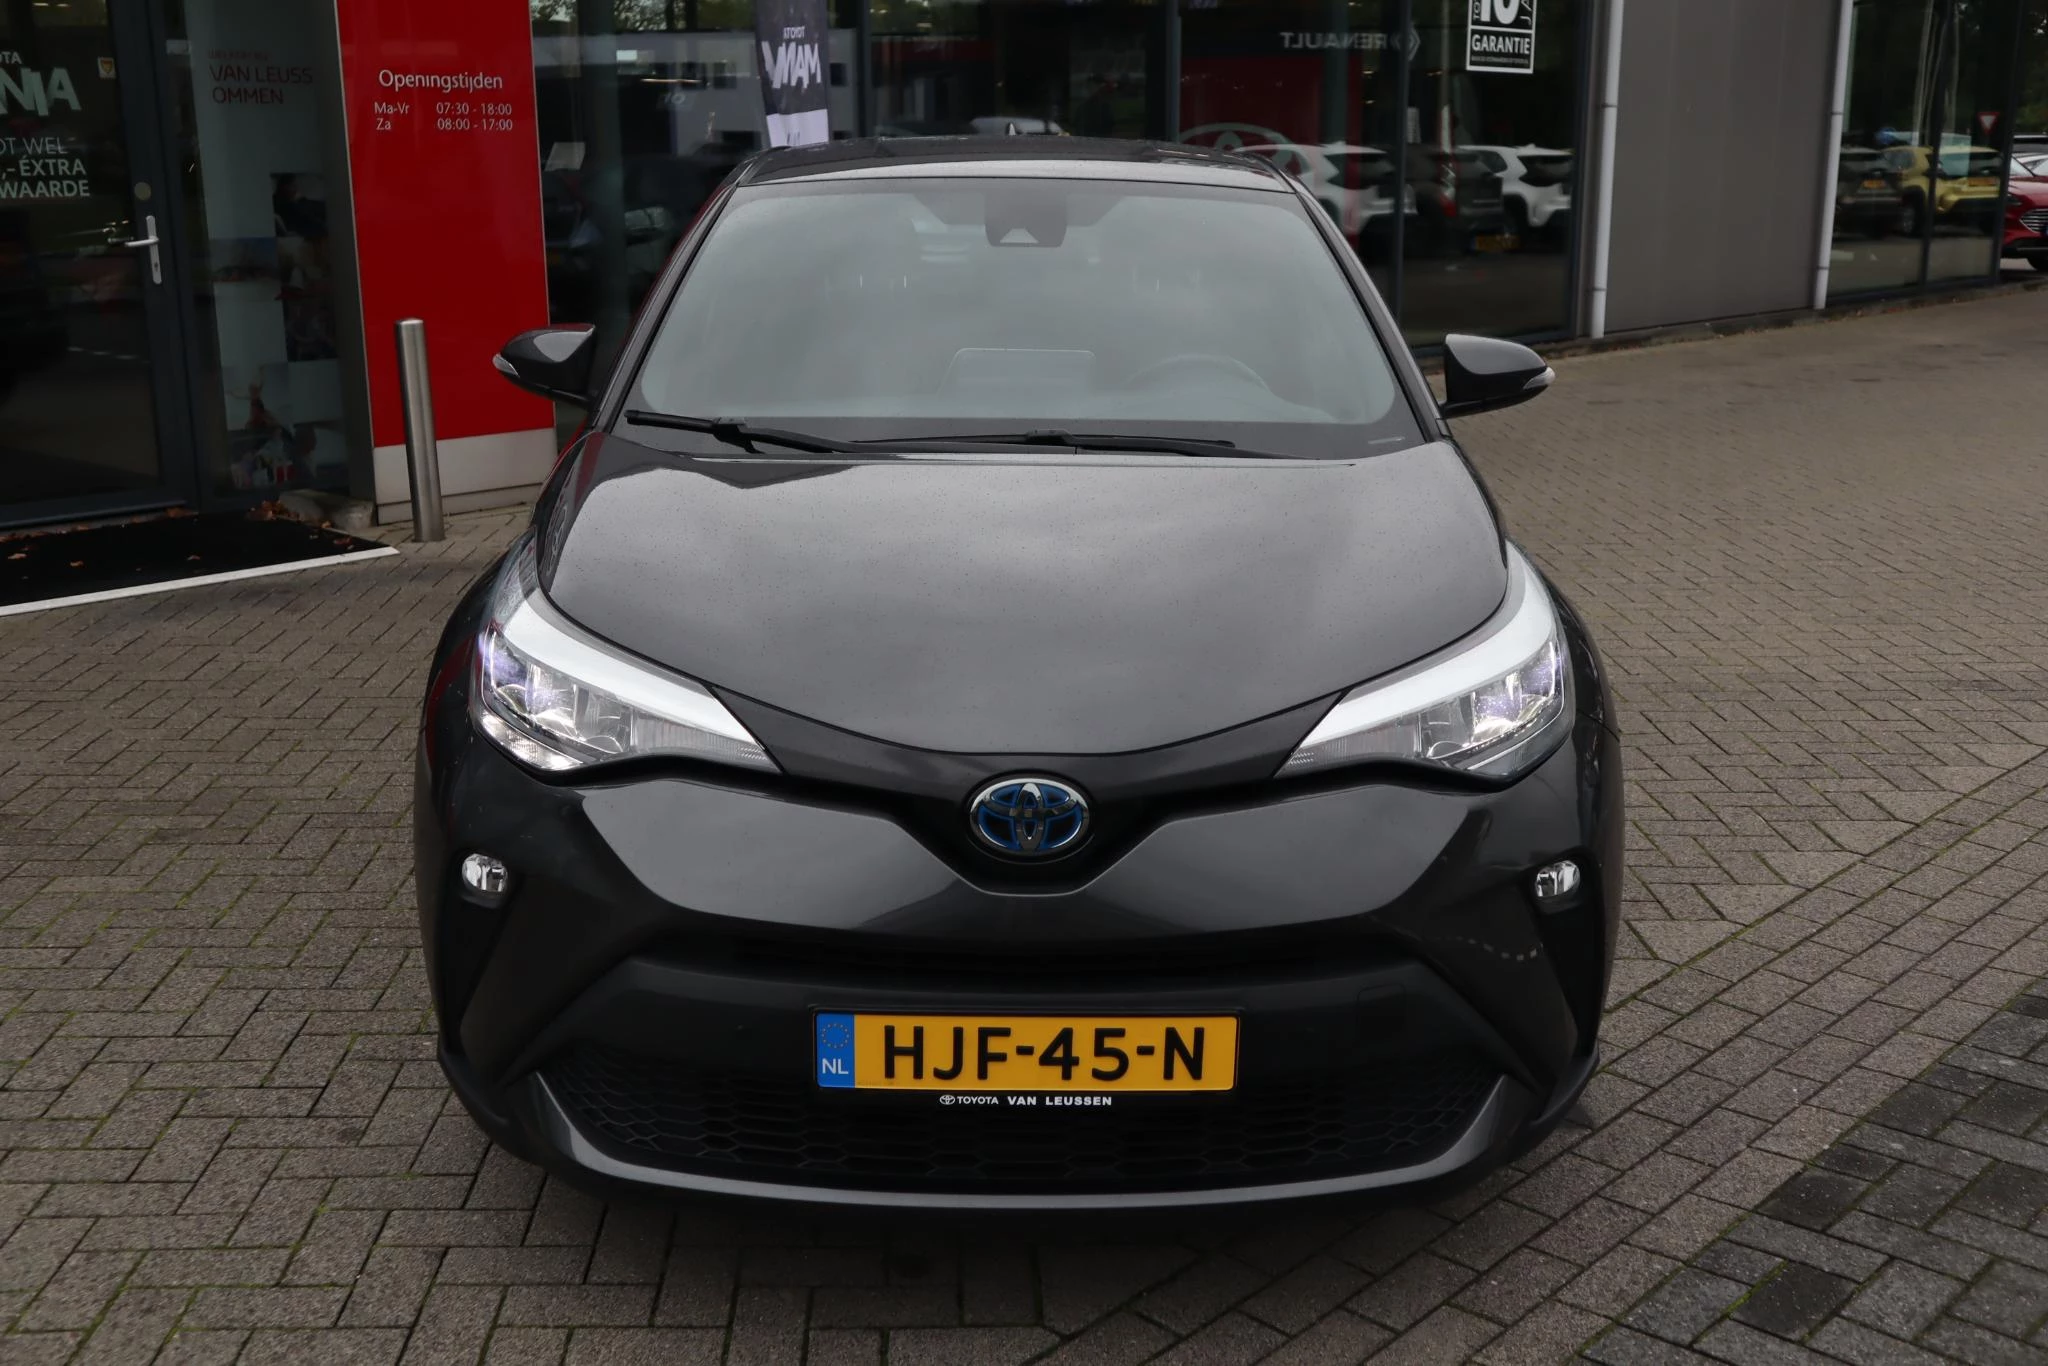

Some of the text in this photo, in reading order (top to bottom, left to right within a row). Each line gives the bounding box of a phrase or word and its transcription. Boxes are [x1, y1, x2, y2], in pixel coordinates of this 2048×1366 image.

[1472, 0, 1480, 20] TO
[1471, 34, 1530, 54] GARANTIE
[0, 51, 22, 64] TA
[209, 64, 313, 84] VAN LEUSS
[378, 69, 503, 93] Openingstijden
[0, 66, 82, 116] NIA
[212, 86, 284, 105] OMMEN
[374, 102, 410, 115] Ma-Vr
[436, 102, 469, 115] 07:30
[482, 103, 512, 116] 18:00
[376, 118, 392, 131] Za
[437, 118, 470, 131] 08:00
[482, 119, 513, 132] 17:00
[22, 137, 68, 154] WEL
[883, 1025, 1205, 1082] HJF-45-N
[821, 1058, 849, 1075] NL
[956, 1095, 1112, 1106] TOYOTA VAN LEUSSEN
